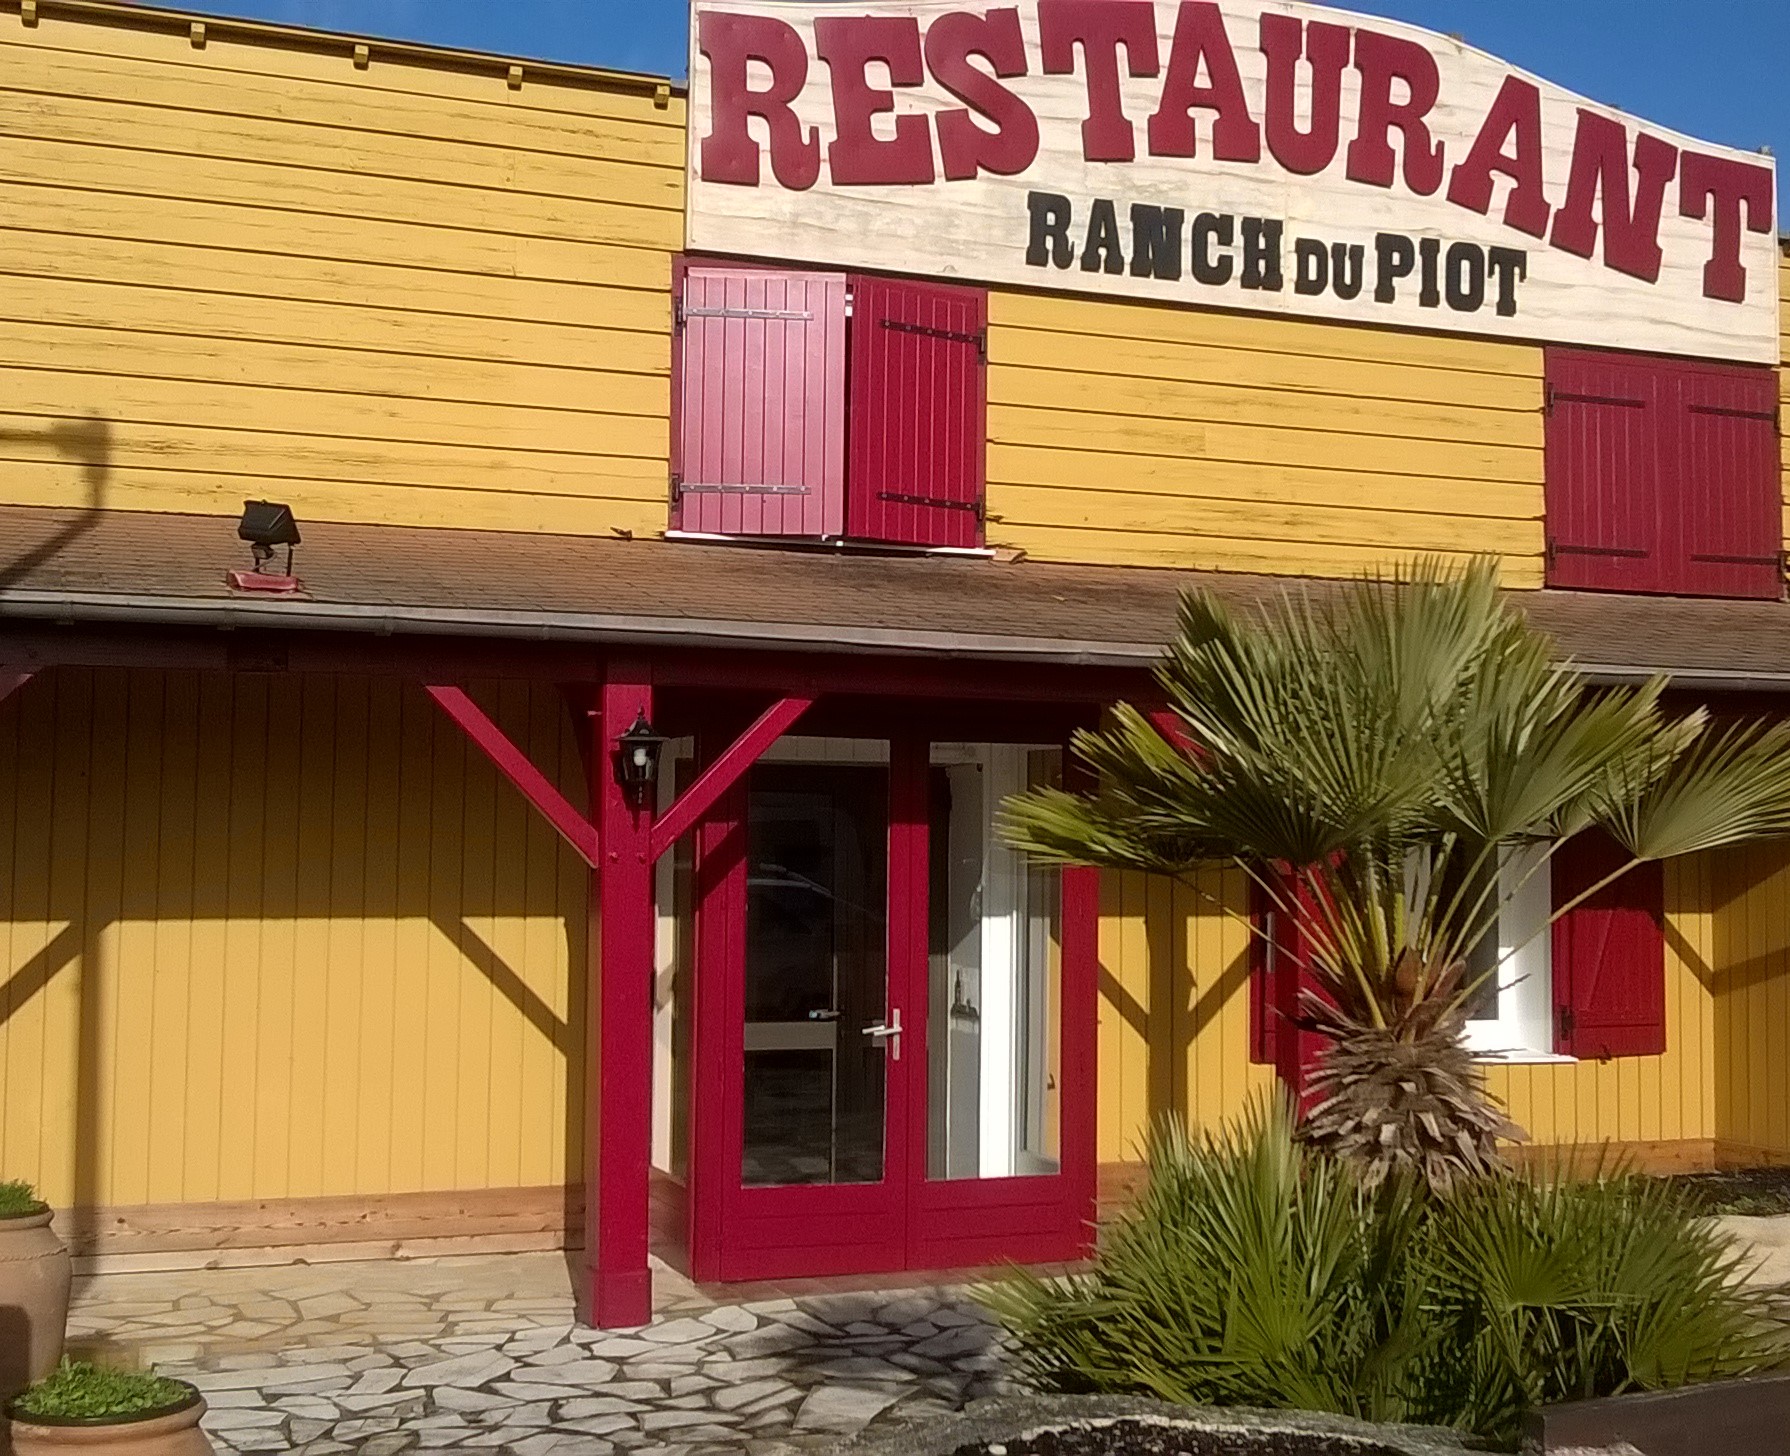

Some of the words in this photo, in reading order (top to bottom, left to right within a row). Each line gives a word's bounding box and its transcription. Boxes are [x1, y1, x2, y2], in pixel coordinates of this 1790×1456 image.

[700, 0, 1773, 304] RESTAURANT
[1025, 190, 1284, 292] RANCH
[1294, 237, 1364, 301] DU
[1374, 232, 1528, 318] PIOT
